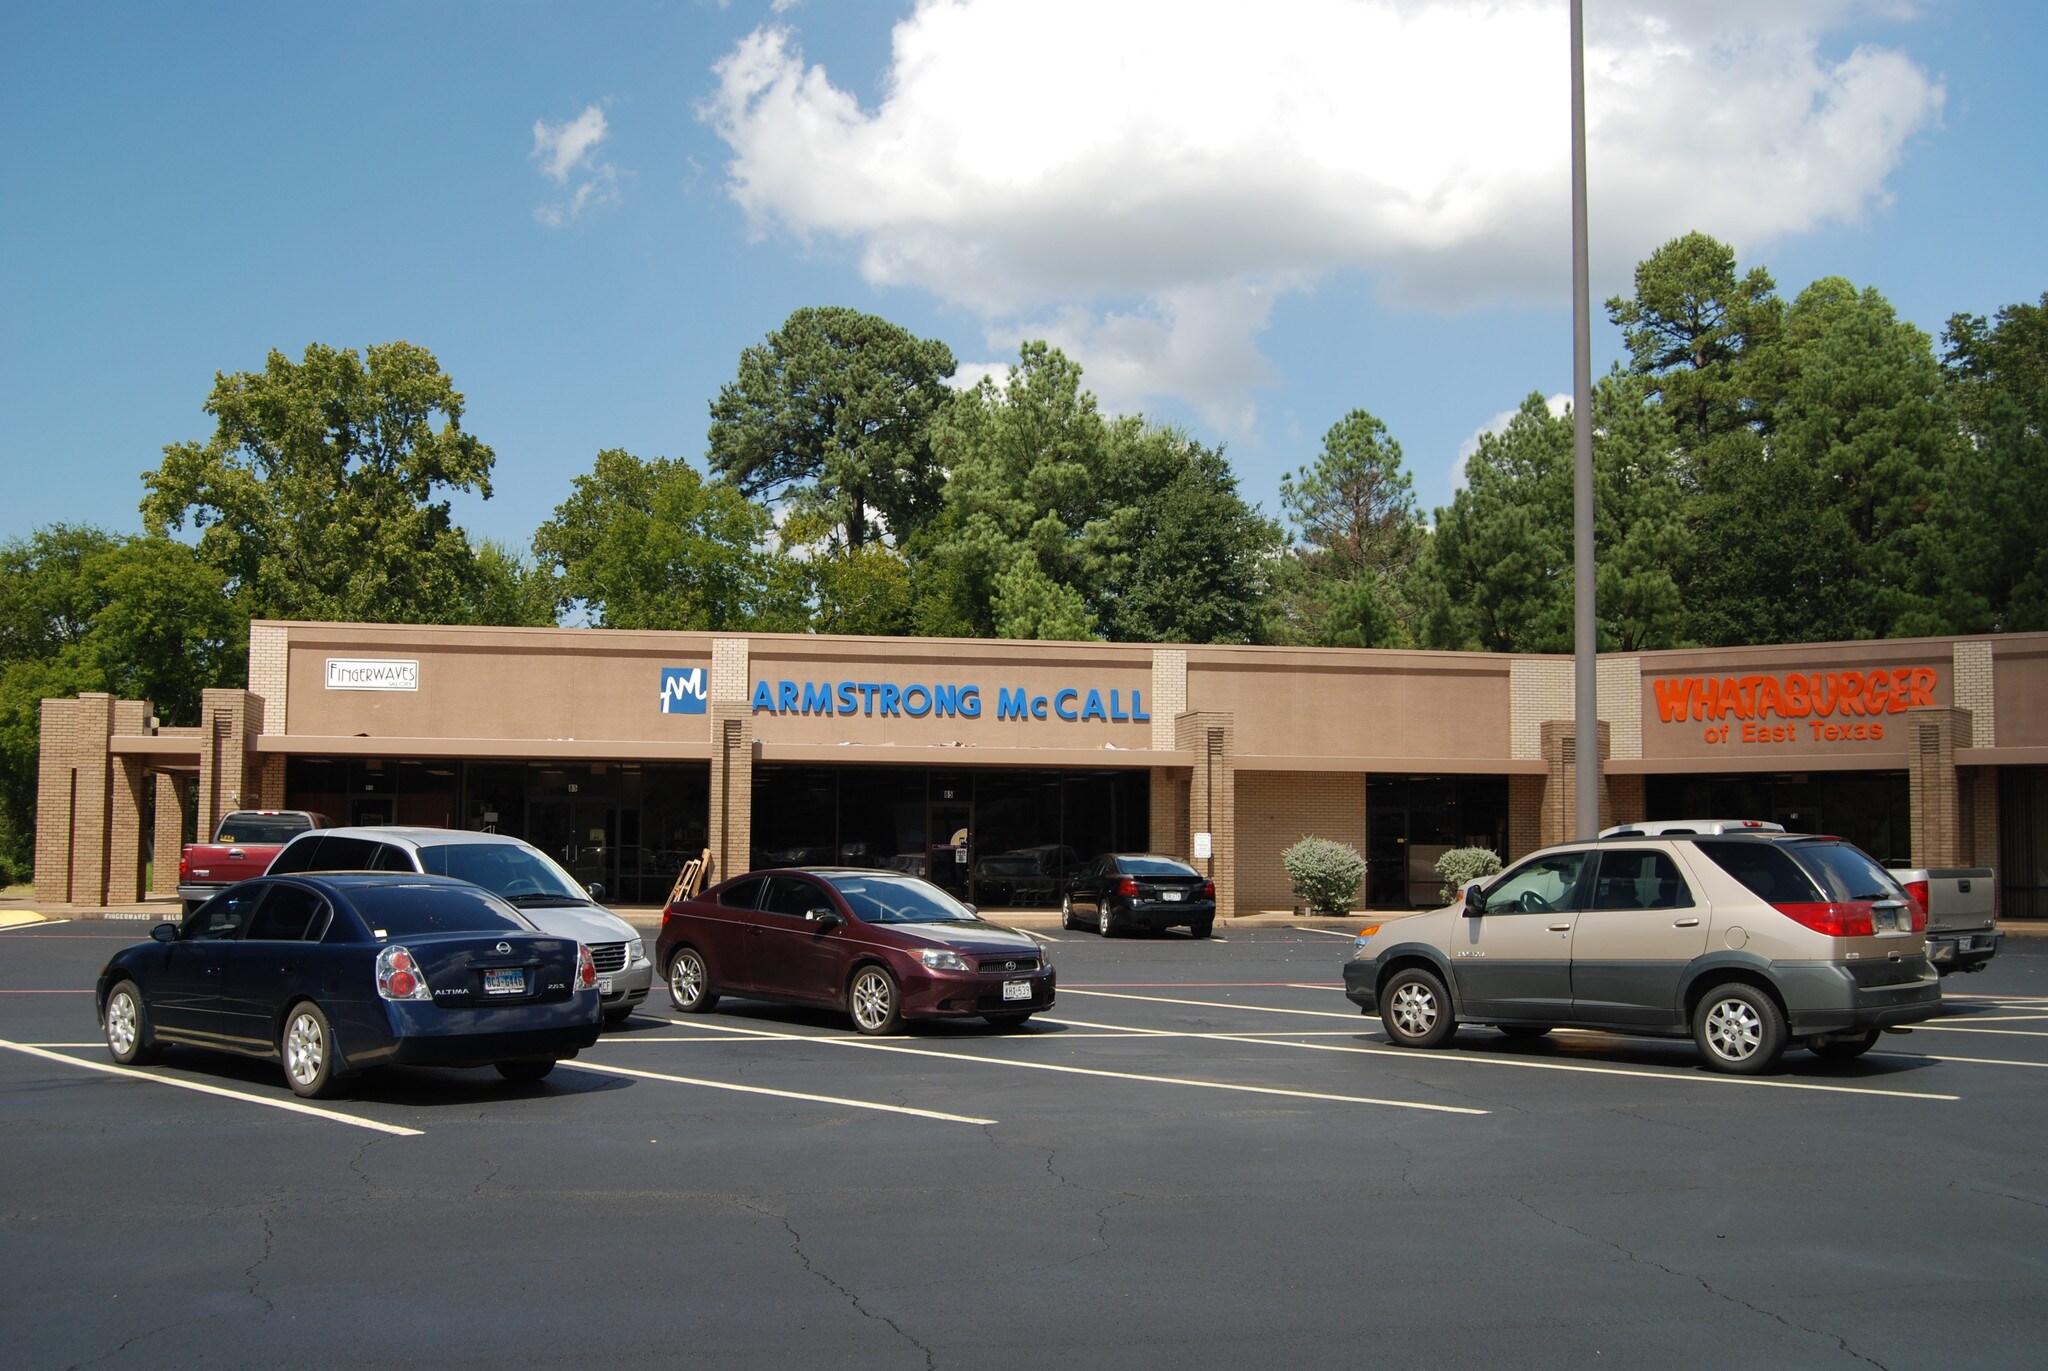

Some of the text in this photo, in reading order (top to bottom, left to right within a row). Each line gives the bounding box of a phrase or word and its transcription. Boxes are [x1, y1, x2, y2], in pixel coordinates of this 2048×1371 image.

[330, 663, 415, 682] FINGERWAVES
[752, 681, 981, 716] ARMSTRONG
[1653, 667, 1937, 722] WHATABURGER
[1703, 720, 1884, 744] of East Texas
